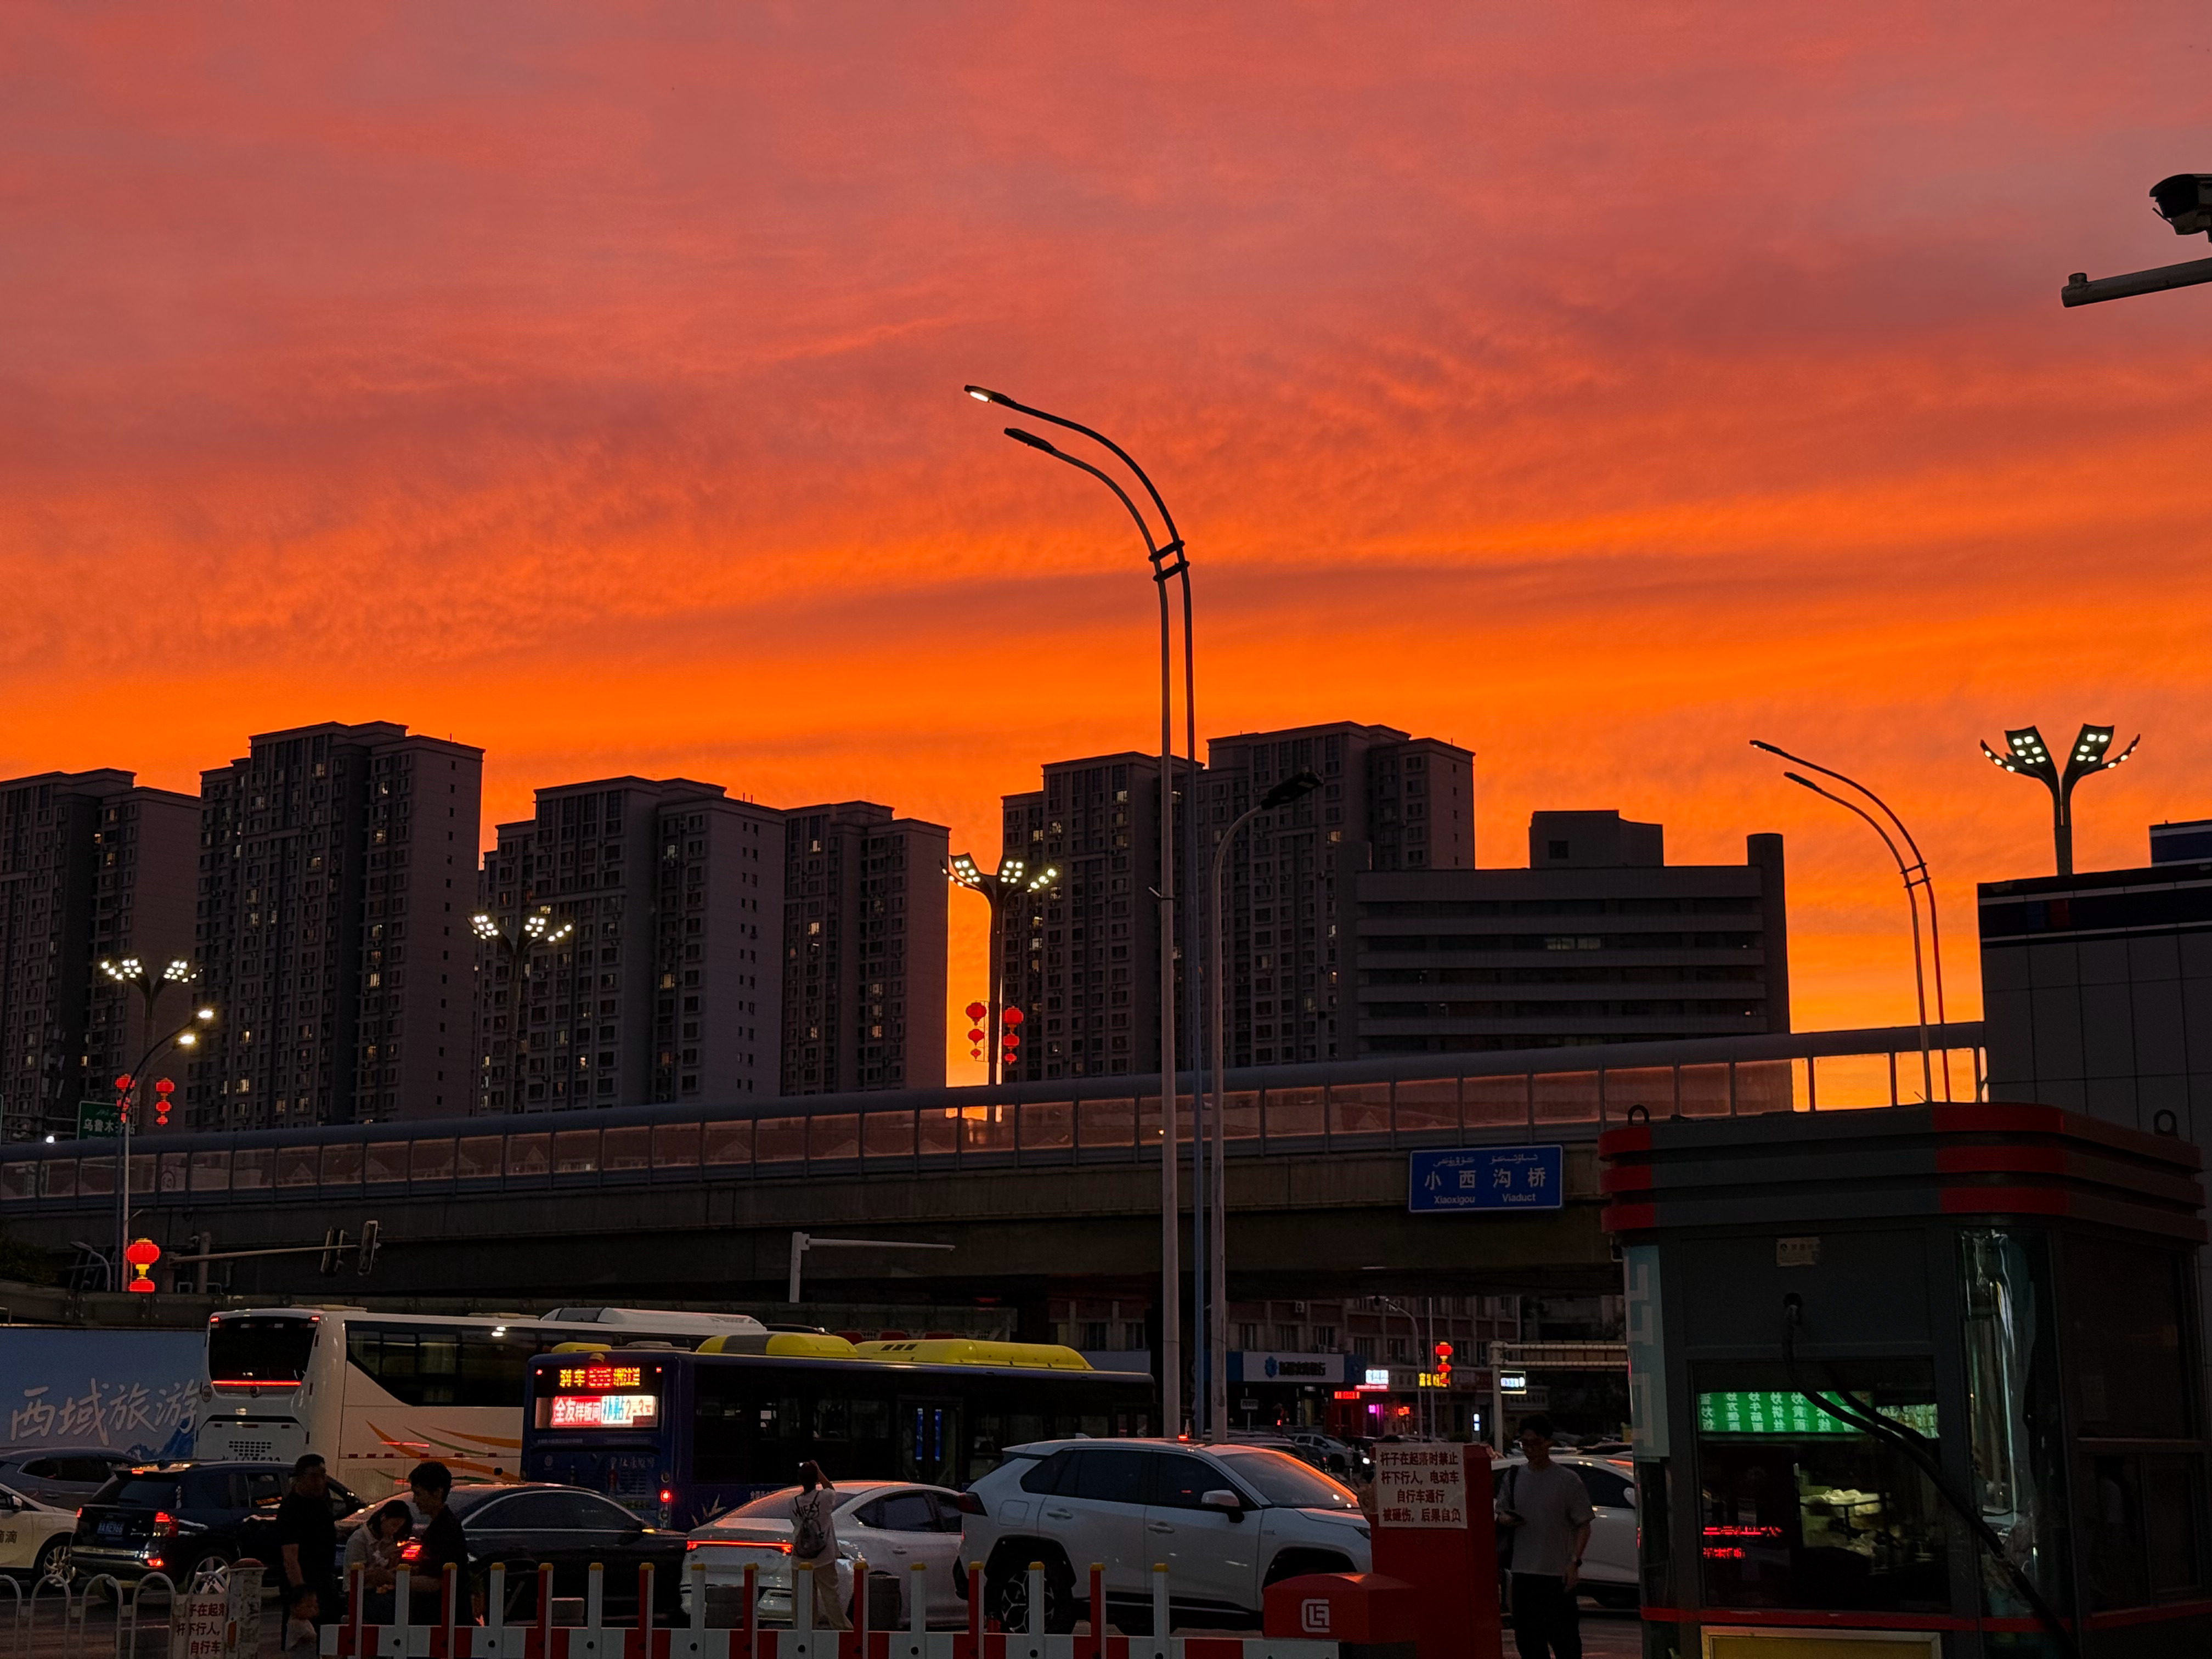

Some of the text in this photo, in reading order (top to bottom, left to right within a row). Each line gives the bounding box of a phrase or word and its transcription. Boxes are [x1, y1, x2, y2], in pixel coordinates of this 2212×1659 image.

[1424, 1167, 1546, 1190] 小西沟桥
[1434, 1193, 1536, 1206] Xiaoxigou Viaduct
[10, 1378, 198, 1446] 西域旅游
[1380, 1451, 1459, 1466] 杆子在起落时禁止
[1397, 1489, 1446, 1503] 自行车通行
